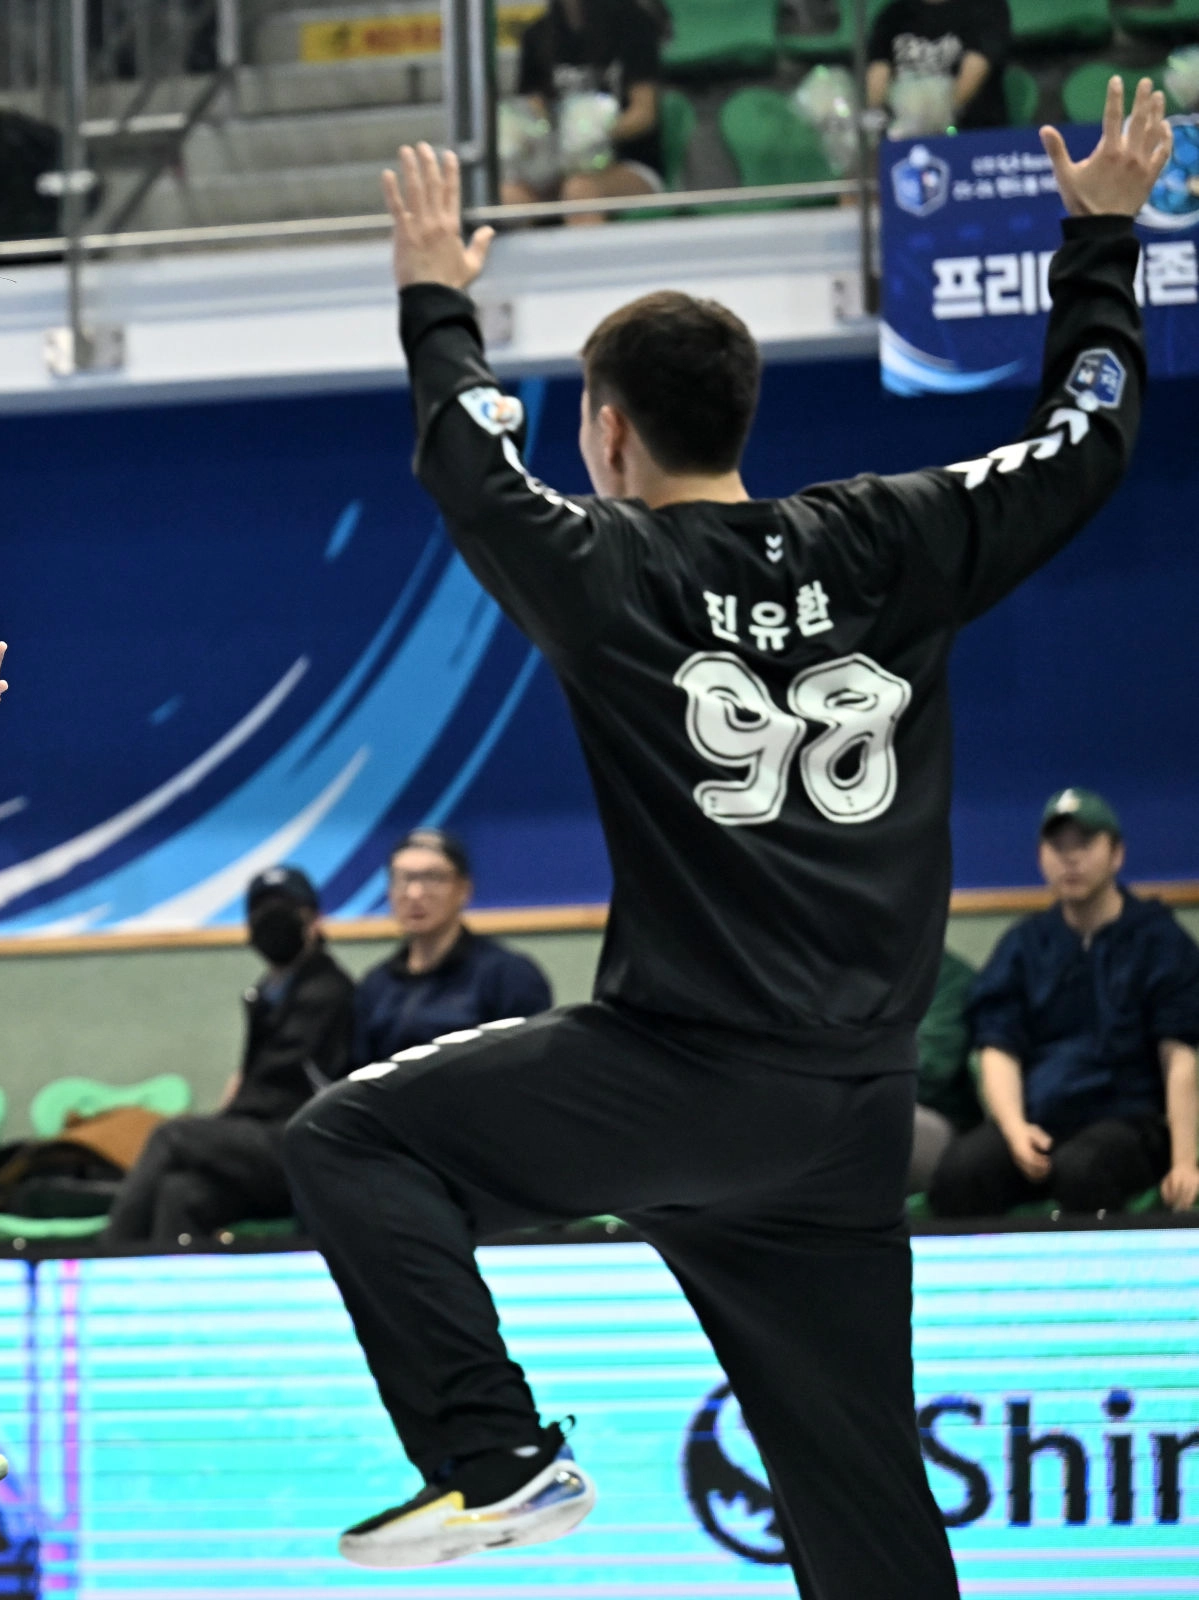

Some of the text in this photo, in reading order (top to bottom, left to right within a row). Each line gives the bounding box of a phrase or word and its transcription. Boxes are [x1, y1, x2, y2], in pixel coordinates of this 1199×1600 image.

[932, 240, 1198, 320] 프리존
[702, 580, 835, 651] 진유환
[672, 651, 912, 826] 98
